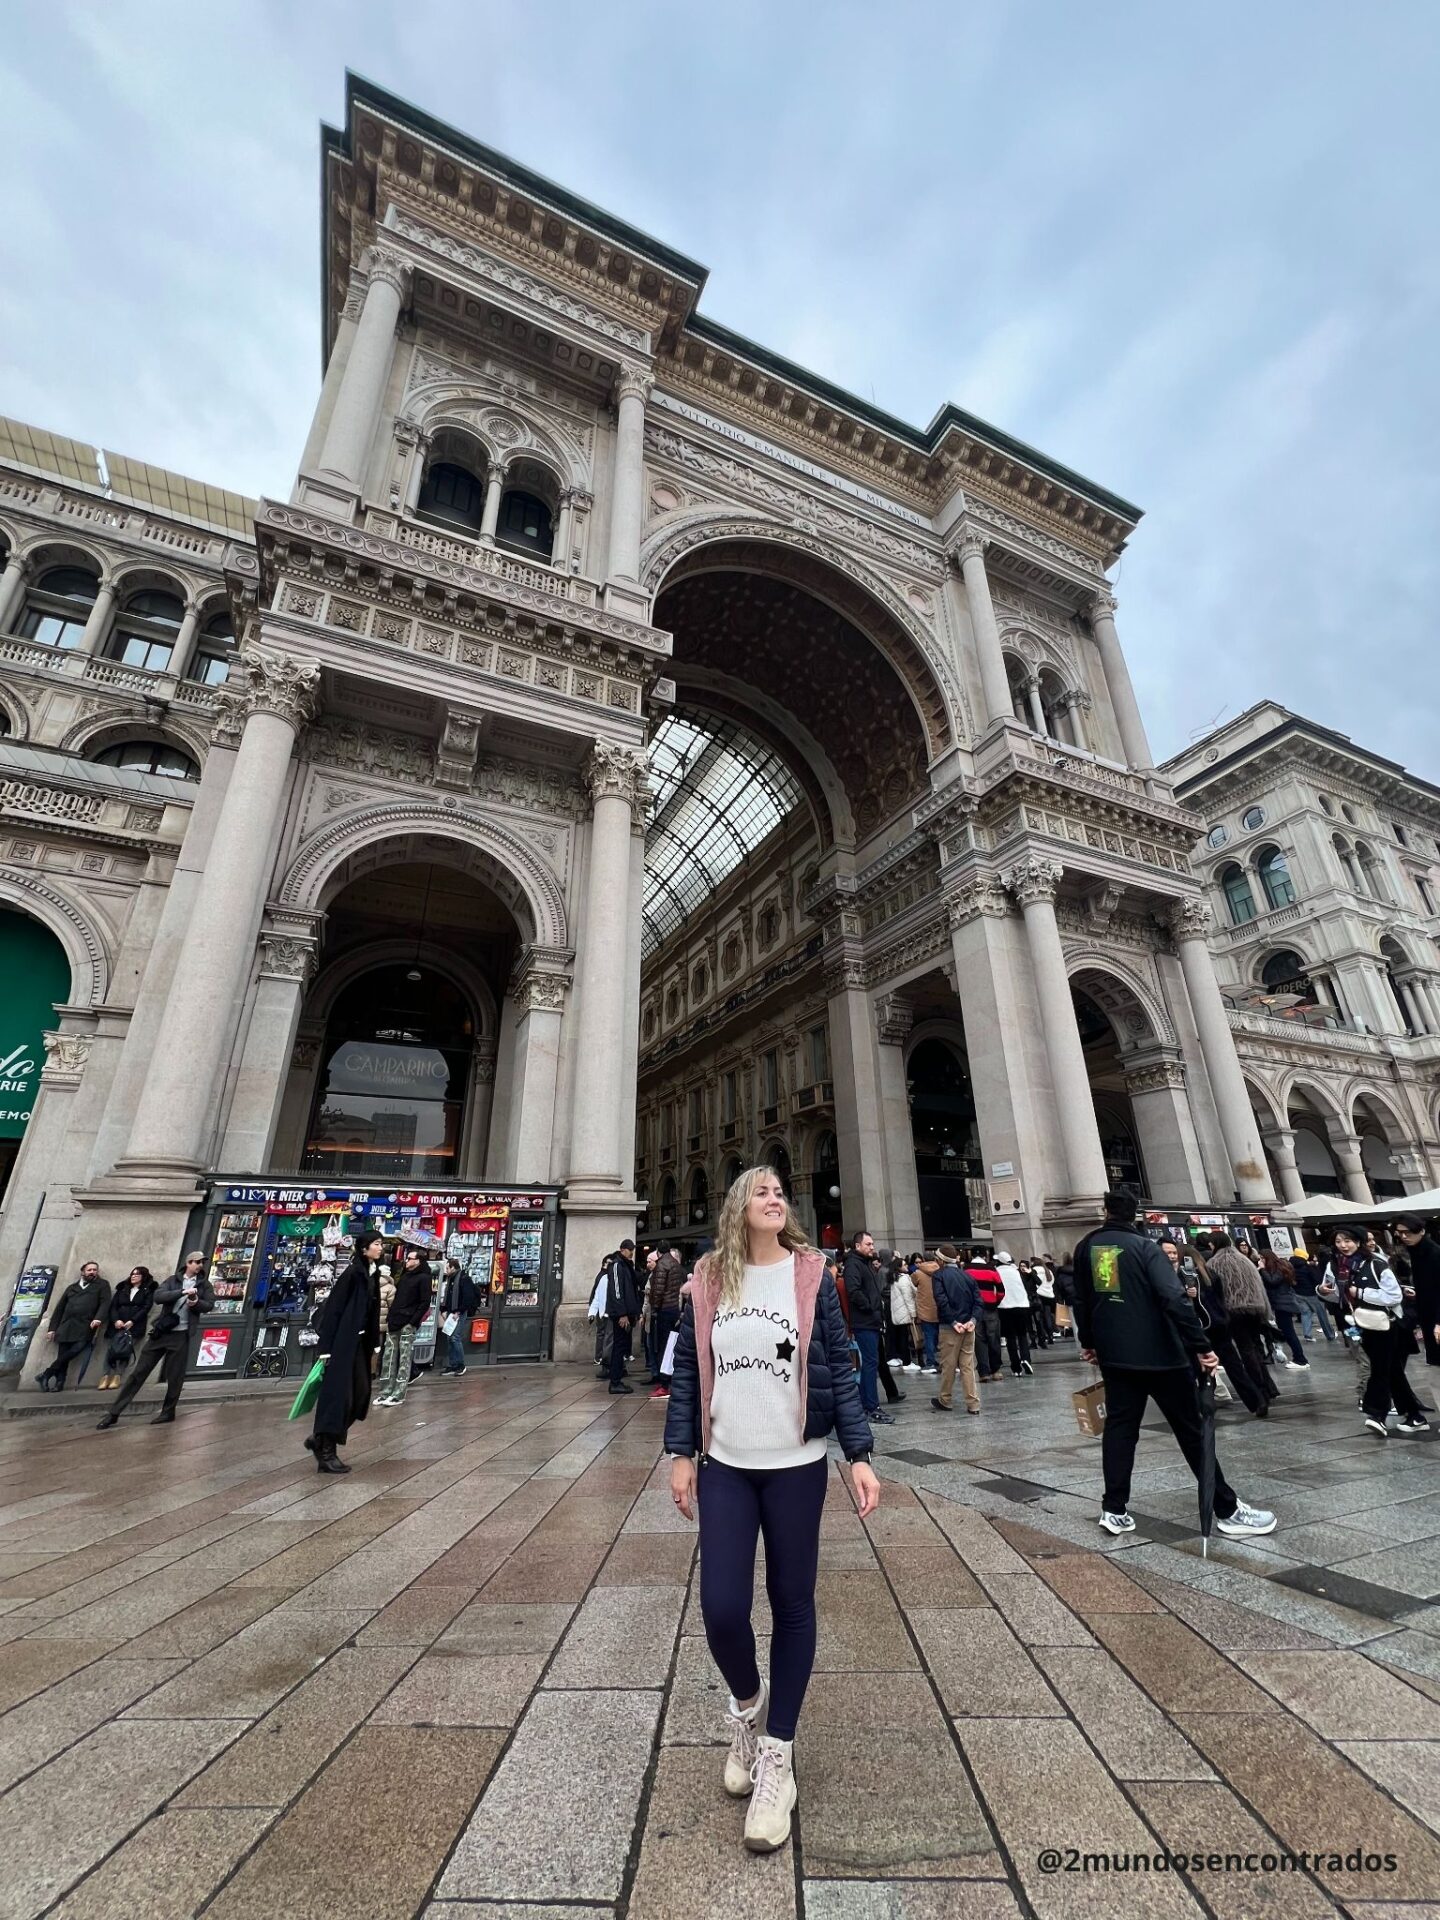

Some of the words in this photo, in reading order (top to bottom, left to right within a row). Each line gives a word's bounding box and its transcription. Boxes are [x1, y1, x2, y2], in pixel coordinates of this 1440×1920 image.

[660, 399, 669, 408] A
[679, 406, 747, 443] VITTORIO
[753, 440, 828, 482] EMANUELE
[865, 493, 921, 525] MILANESI
[344, 1054, 448, 1079] CAMPARINO
[0, 1081, 28, 1092] RIE
[241, 1188, 246, 1200] I
[279, 1190, 304, 1202] INTER
[348, 1193, 369, 1203] INTER
[417, 1195, 430, 1204] AC
[431, 1196, 457, 1204] MILAN
[718, 1353, 791, 1383] dreams
